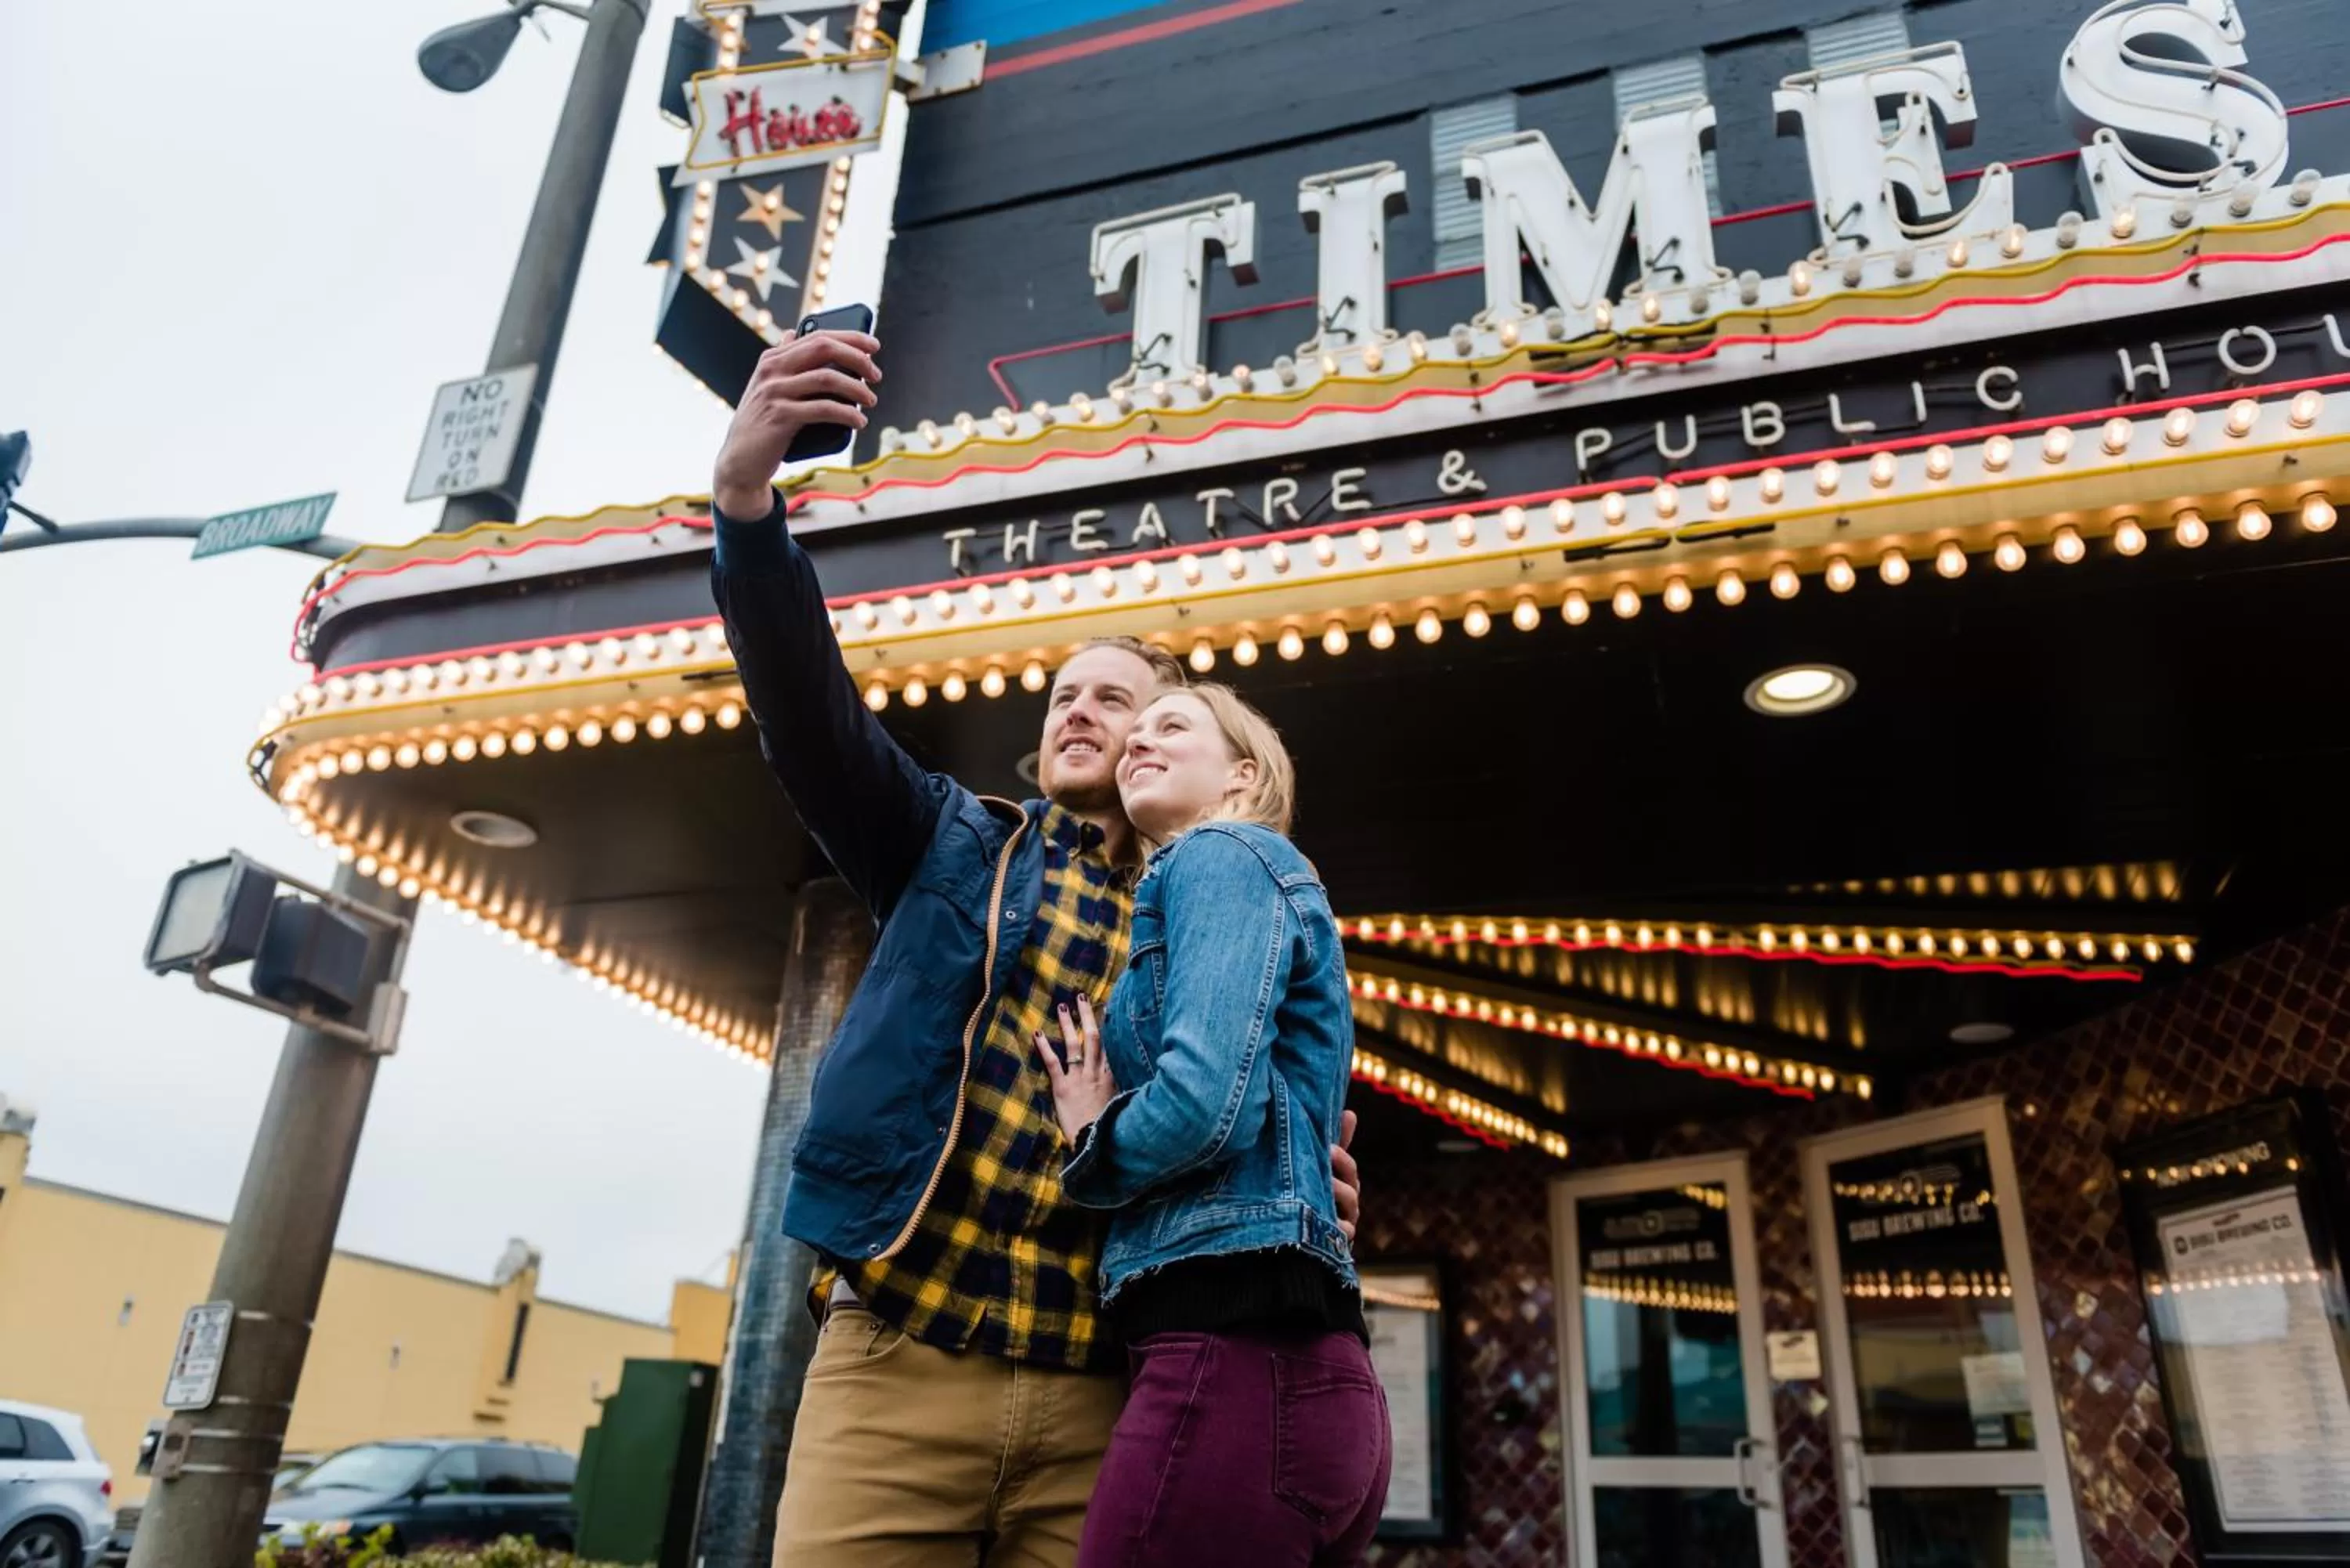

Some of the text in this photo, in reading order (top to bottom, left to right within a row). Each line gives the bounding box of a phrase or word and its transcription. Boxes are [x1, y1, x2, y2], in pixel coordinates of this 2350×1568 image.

[718, 85, 861, 161] House
[1091, 0, 2289, 397] TIMES
[460, 379, 503, 405] NO
[442, 399, 510, 428] RIGHT
[442, 423, 501, 450] TURN
[447, 447, 481, 470] ON
[943, 468, 1372, 567] THEATRE
[1437, 450, 1487, 494] &
[1574, 366, 2023, 470] PUBLIC
[436, 467, 480, 490] RED
[197, 497, 330, 553] BROADWAY
